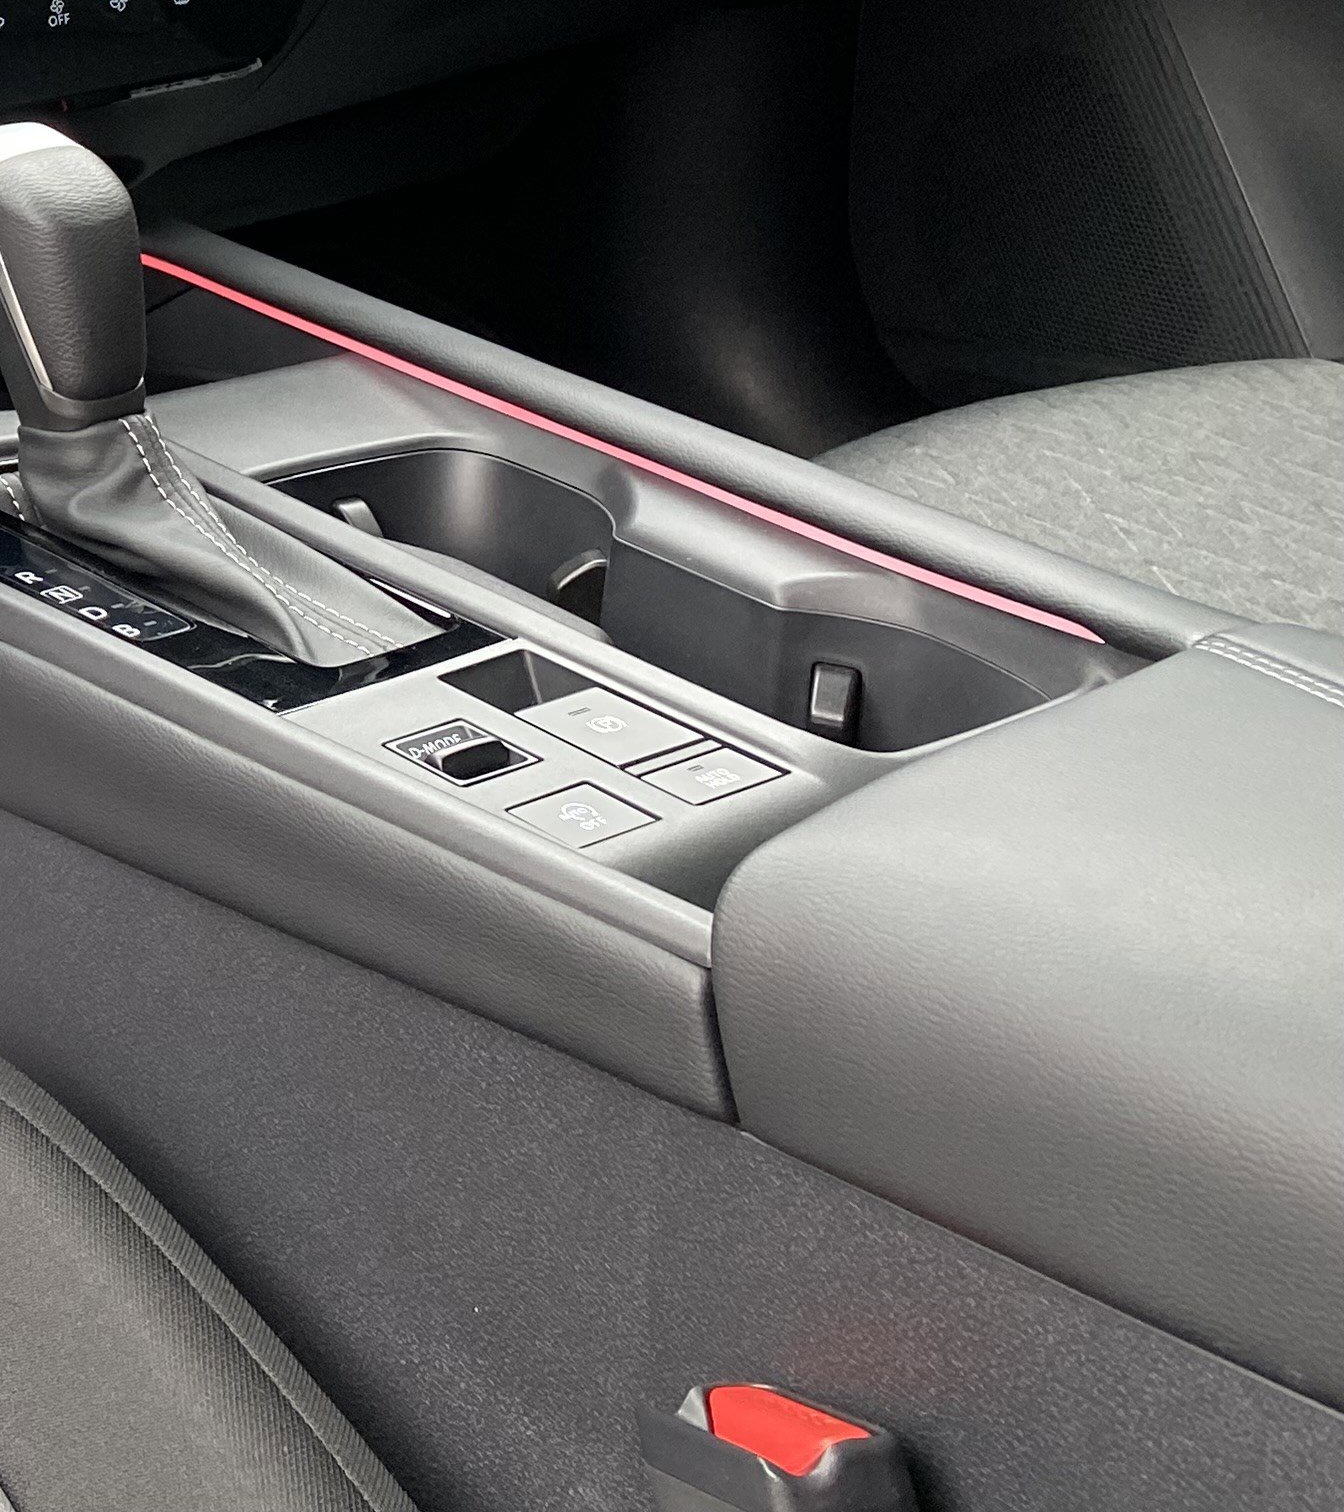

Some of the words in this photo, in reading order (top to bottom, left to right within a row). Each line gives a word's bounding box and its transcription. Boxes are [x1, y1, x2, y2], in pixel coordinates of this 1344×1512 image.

[47, 12, 71, 28] OFF
[14, 571, 44, 584] R
[78, 606, 108, 620] D
[112, 623, 141, 638] B
